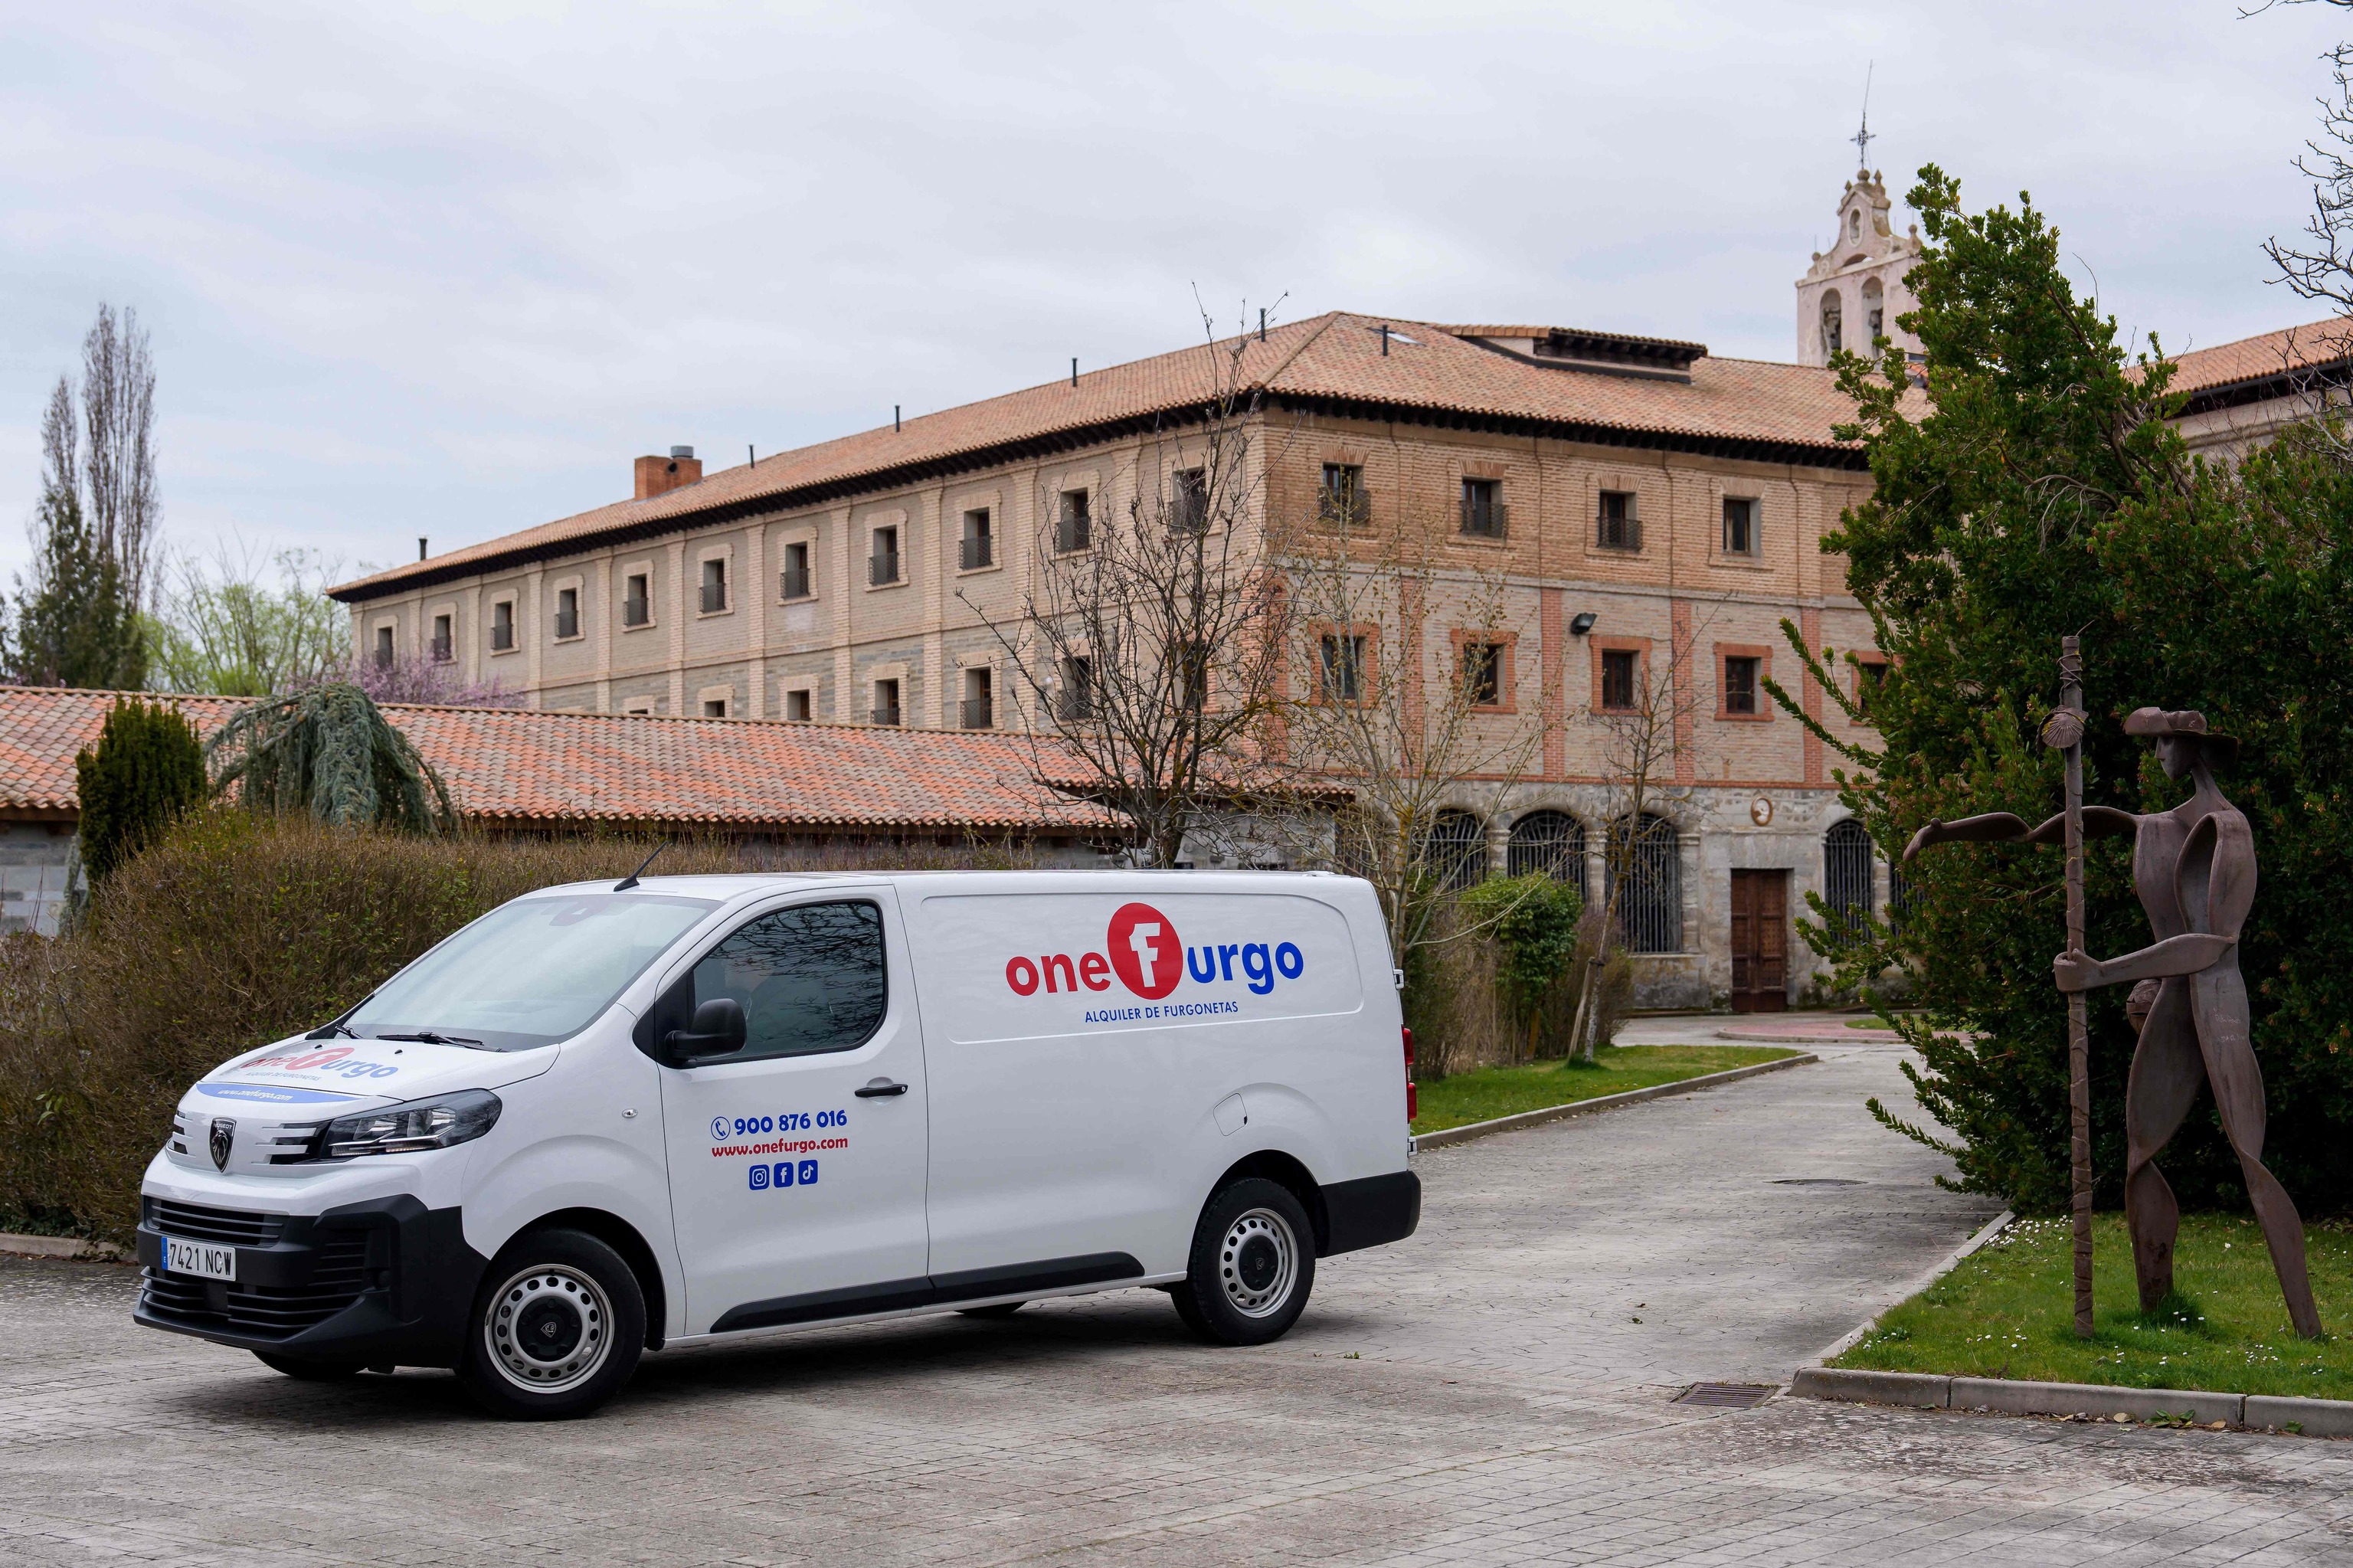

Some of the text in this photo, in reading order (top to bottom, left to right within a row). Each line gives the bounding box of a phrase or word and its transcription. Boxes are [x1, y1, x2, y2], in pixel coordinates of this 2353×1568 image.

[1085, 1000, 1239, 1023] ALQUILER DE FURGONETAS
[217, 1089, 293, 1101] www.onefurgo.com
[734, 1109, 848, 1136] 900 876 016
[711, 1138, 849, 1157] www.onefurgo.com
[170, 1243, 231, 1276] 7421 NCW
